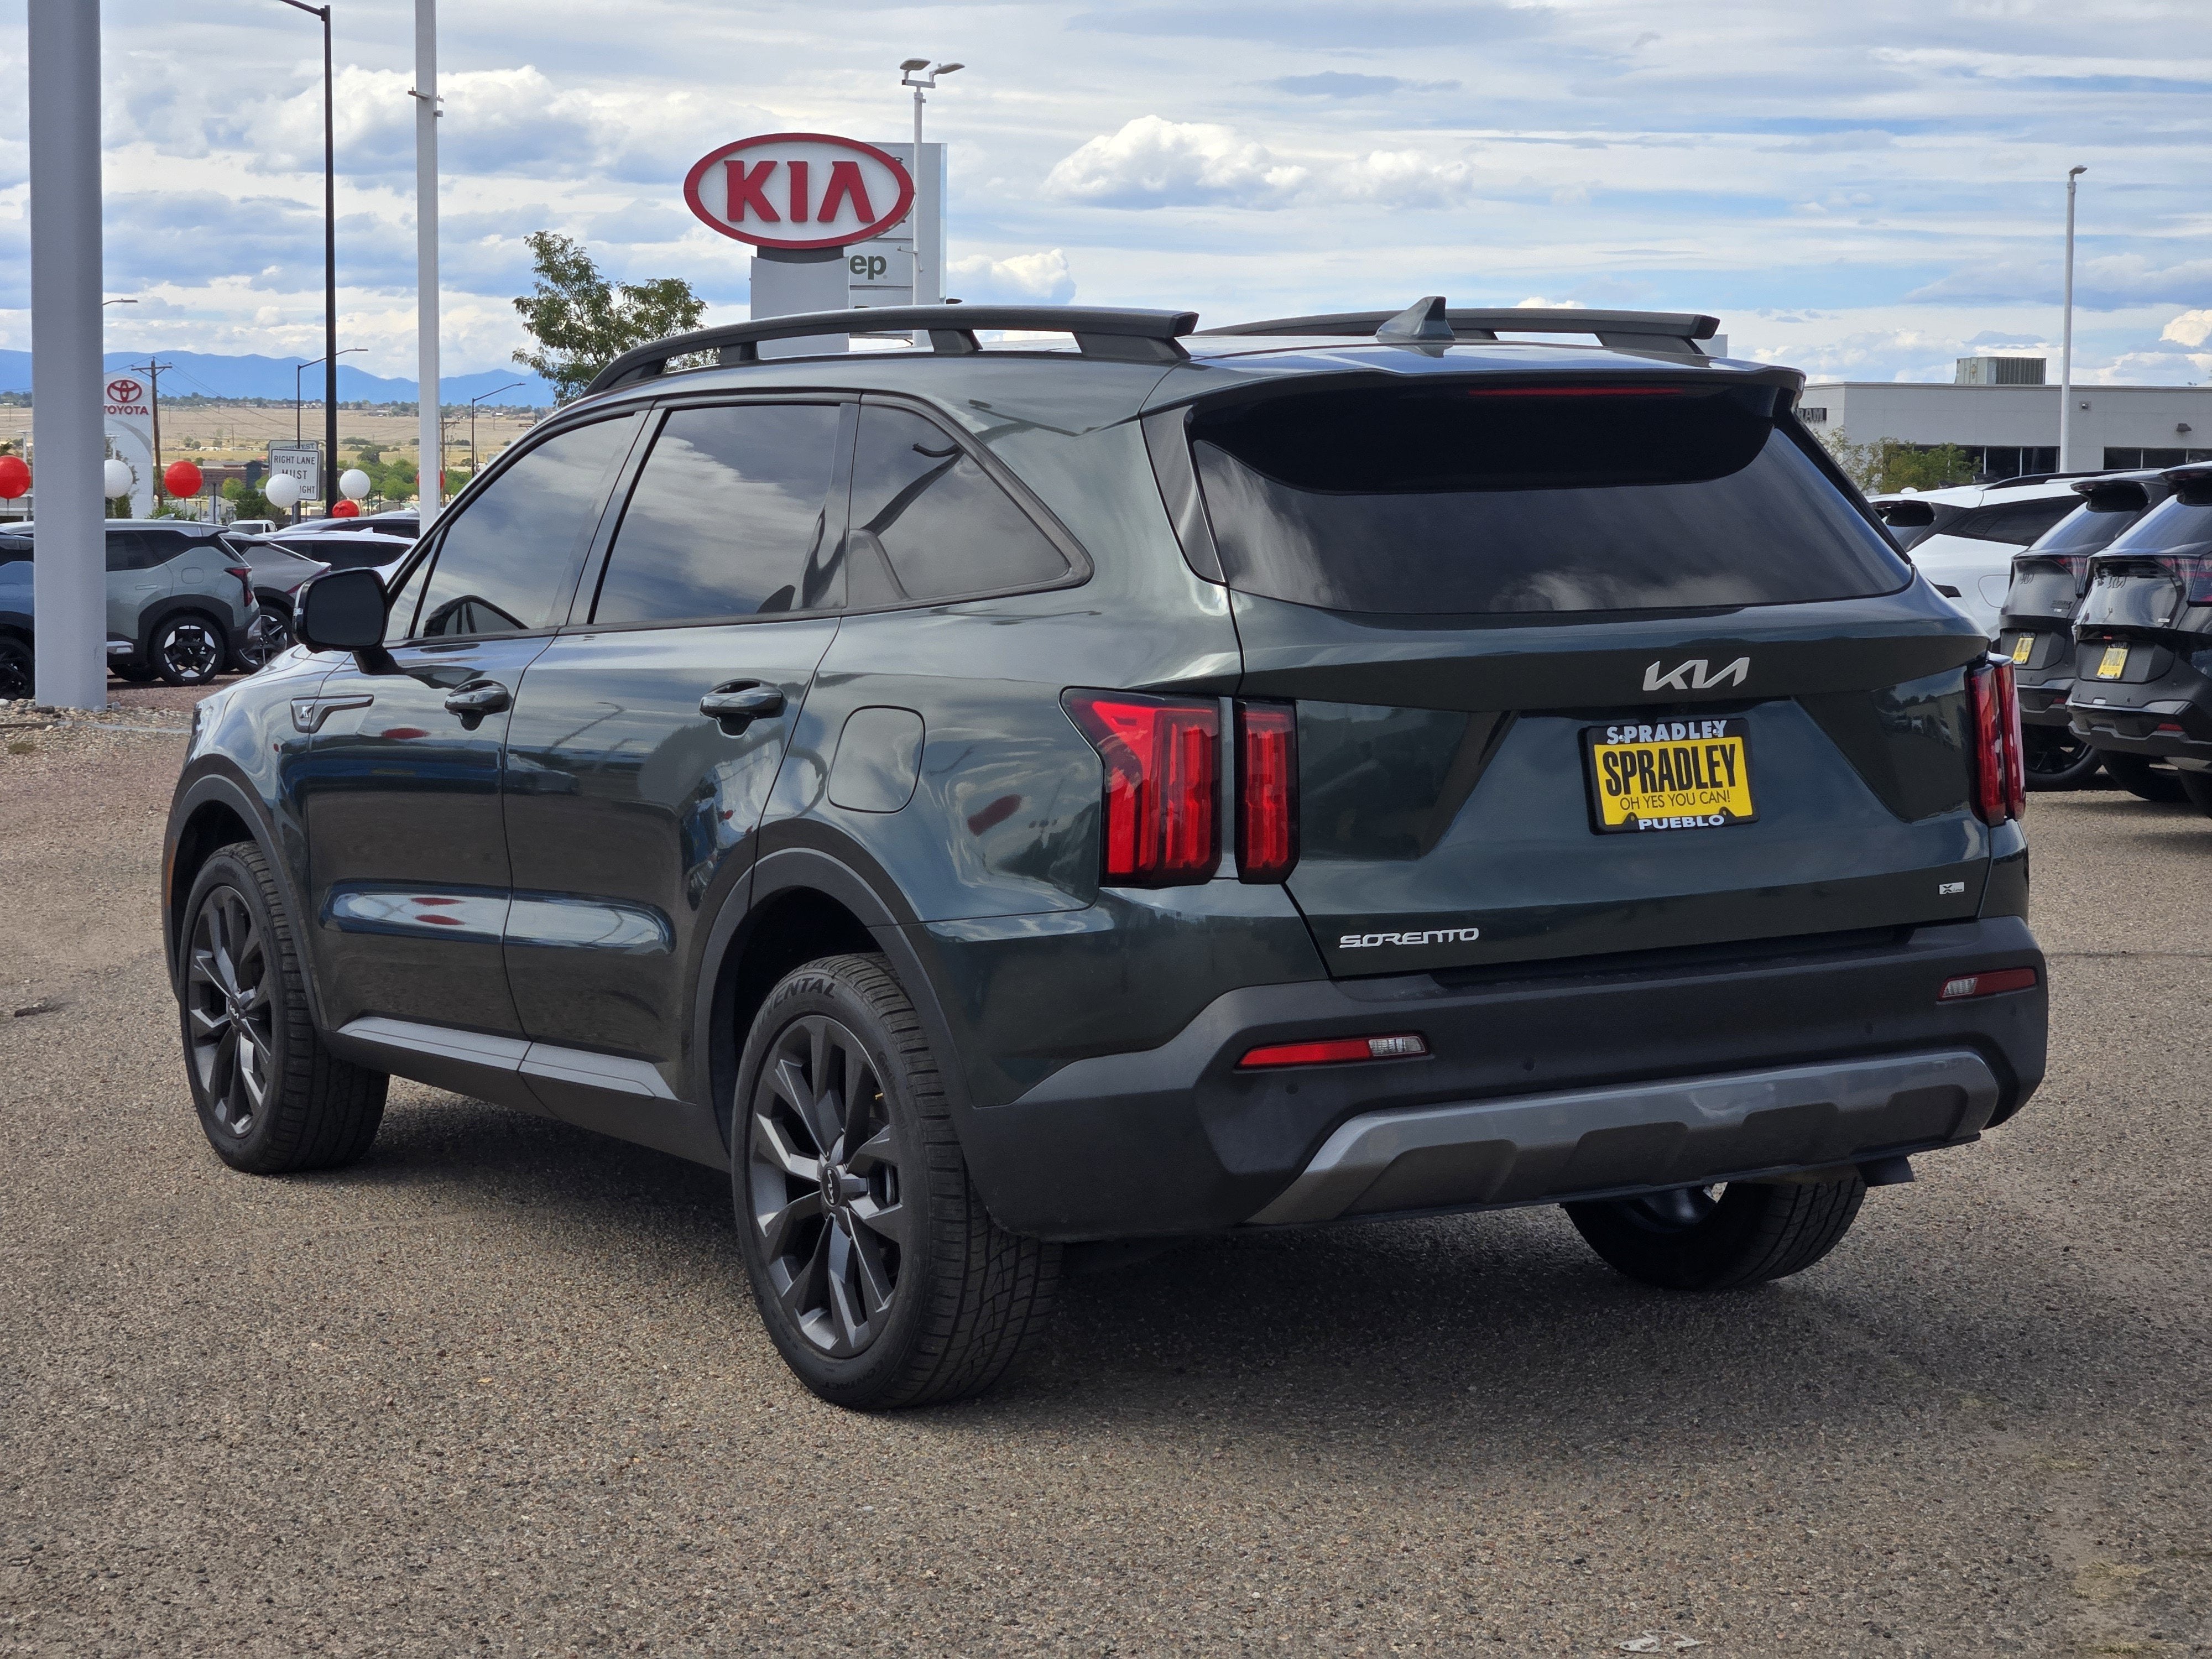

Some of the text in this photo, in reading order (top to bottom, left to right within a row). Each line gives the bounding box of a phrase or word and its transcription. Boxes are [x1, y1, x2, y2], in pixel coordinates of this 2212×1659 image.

[724, 160, 875, 222] KIA
[849, 255, 886, 280] ep
[274, 455, 315, 465] RIGHT LANE
[300, 486, 315, 494] IGHT
[1642, 657, 1750, 691] KIA
[1606, 720, 1727, 744] SPRADLEY
[1603, 744, 1736, 796] SPRADLEY
[1620, 789, 1731, 811] OH YES YOU CAN!
[1638, 815, 1725, 830] PUEBLO
[1339, 928, 1479, 948] SORENTO
